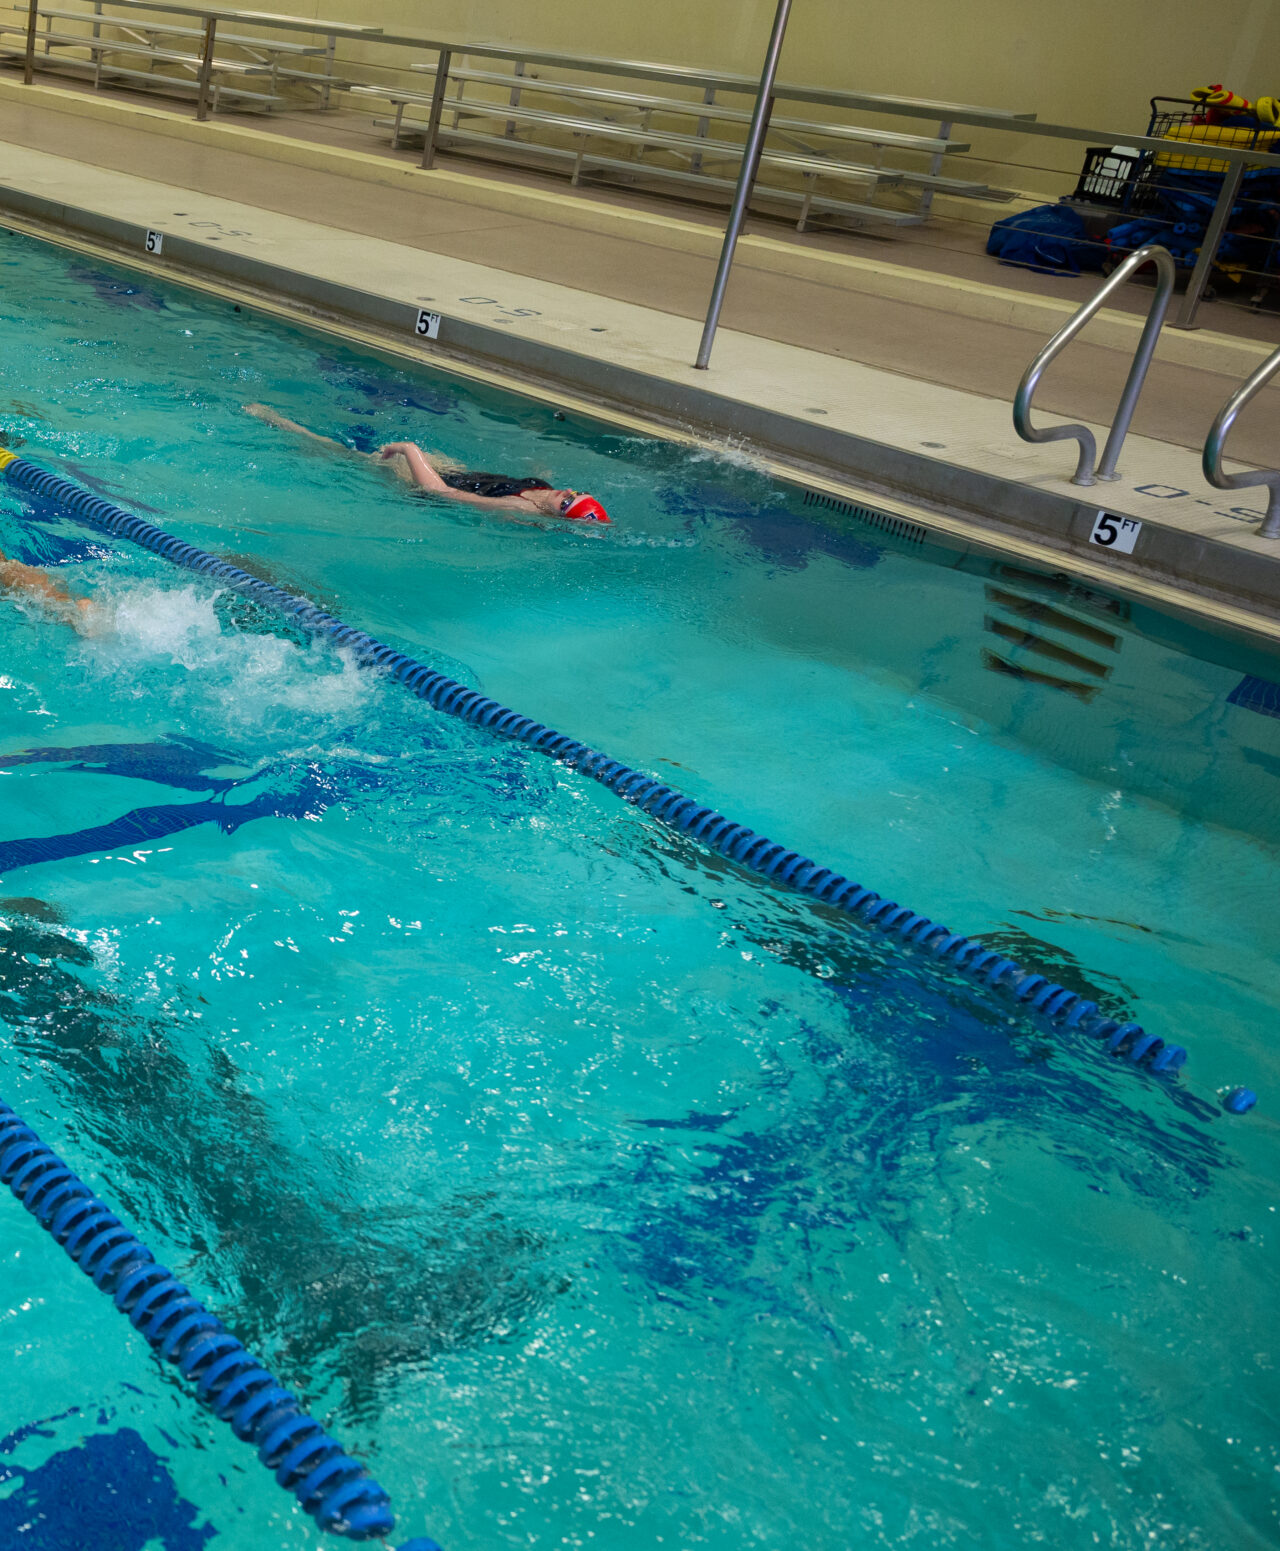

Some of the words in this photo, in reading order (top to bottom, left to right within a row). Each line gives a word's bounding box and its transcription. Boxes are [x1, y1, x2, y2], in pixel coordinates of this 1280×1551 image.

[146, 231, 156, 251] 5
[417, 310, 431, 335] 5
[430, 313, 440, 324] FT
[1093, 512, 1122, 546] 5
[1121, 518, 1140, 533] FT
